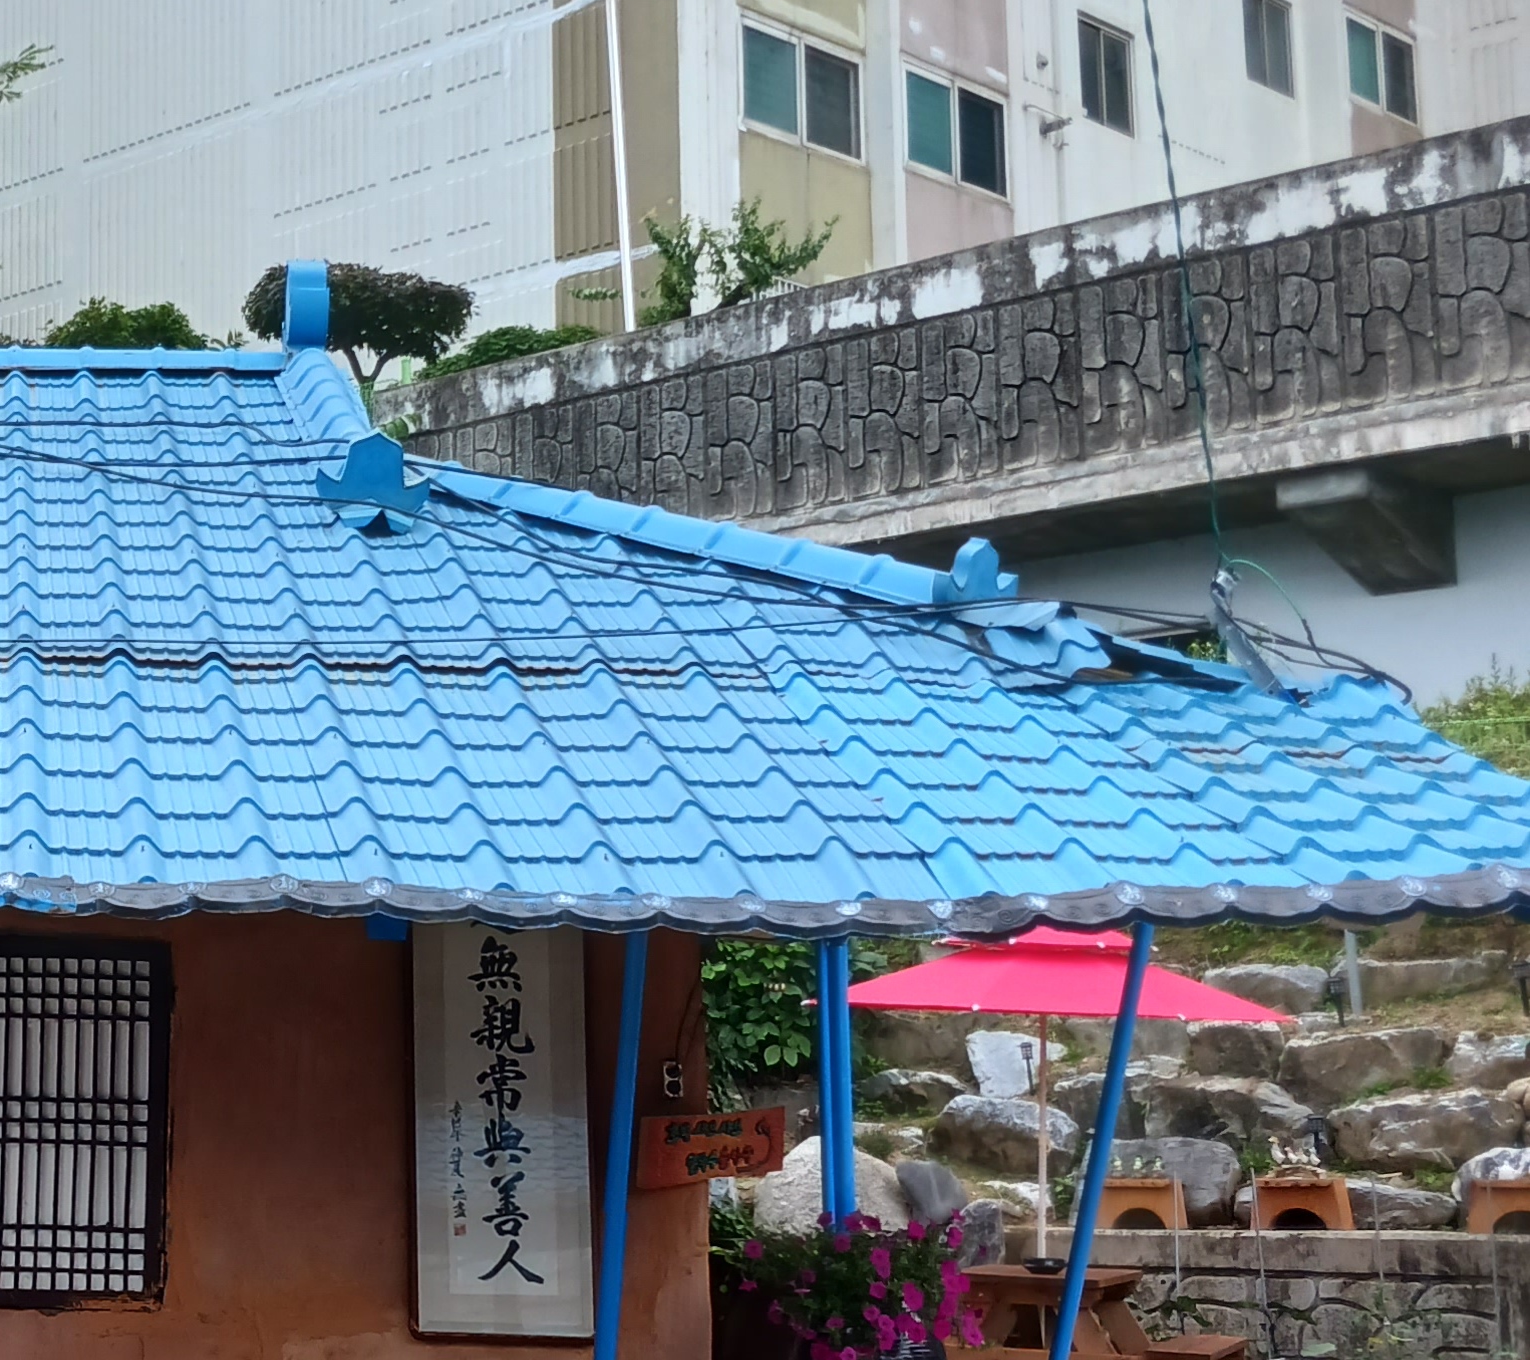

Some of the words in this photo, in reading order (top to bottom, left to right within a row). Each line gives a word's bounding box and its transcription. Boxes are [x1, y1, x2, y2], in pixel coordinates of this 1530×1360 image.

[467, 921, 545, 1285] 無親常與善人
